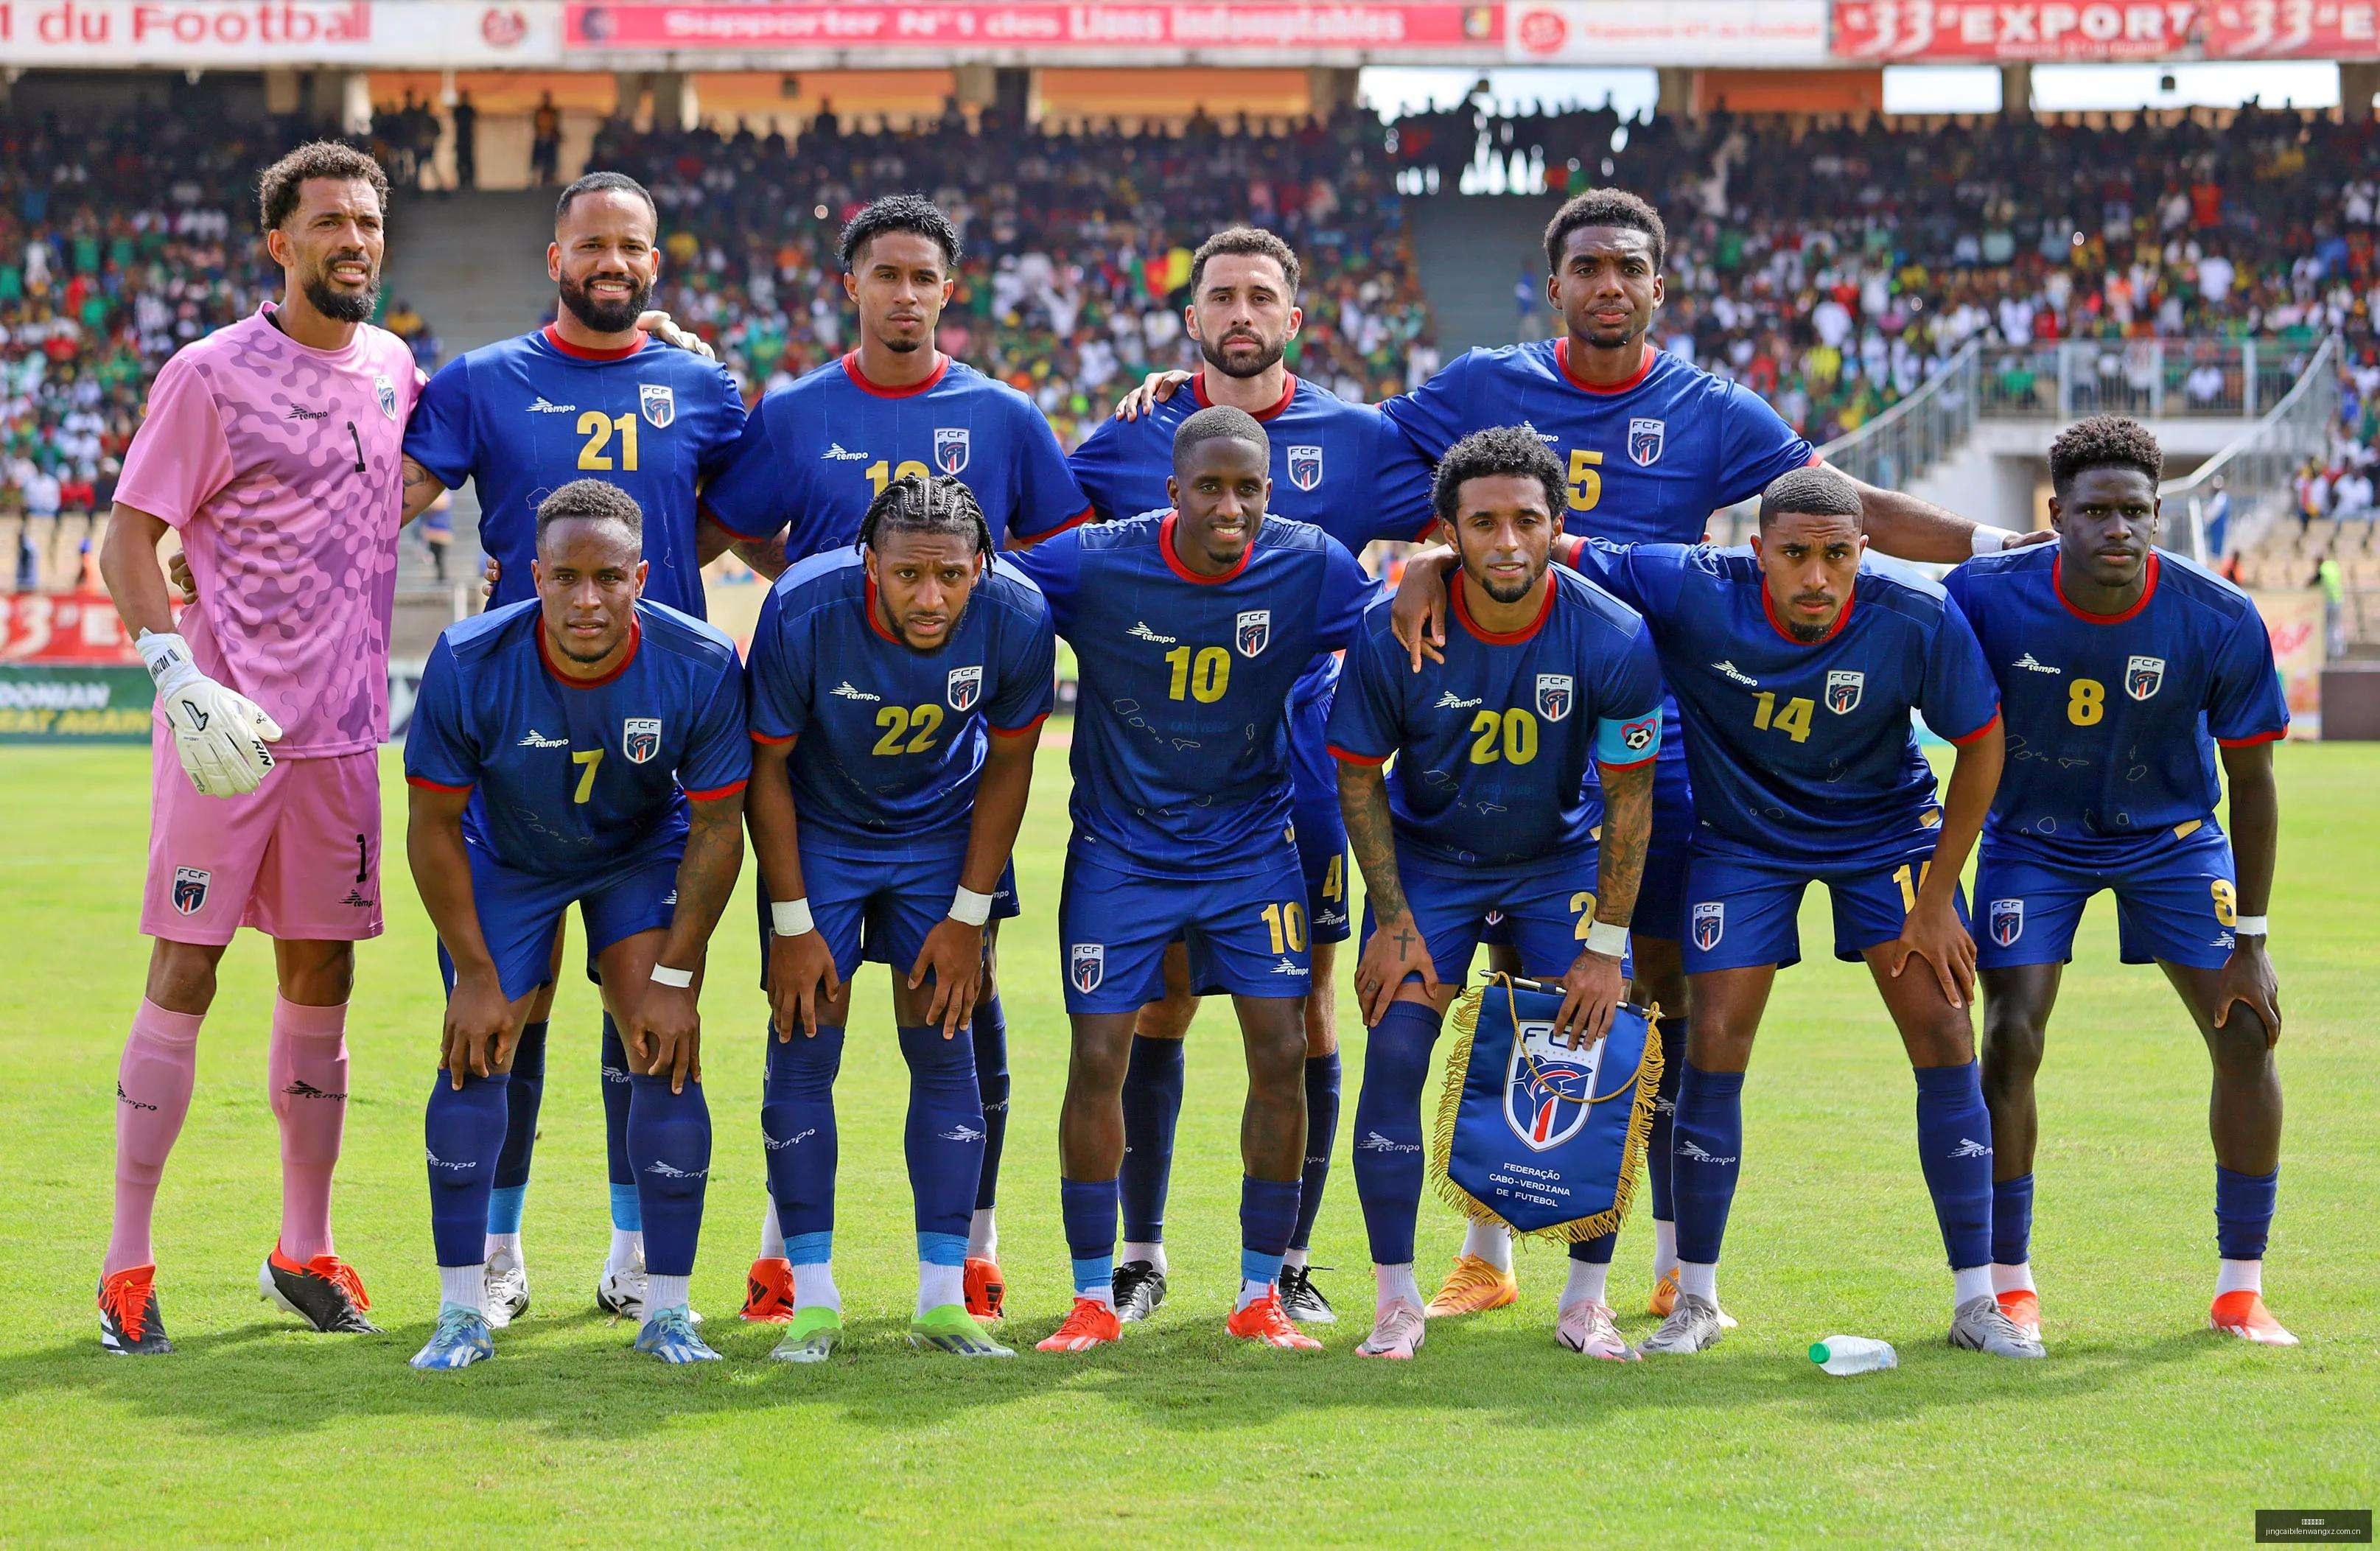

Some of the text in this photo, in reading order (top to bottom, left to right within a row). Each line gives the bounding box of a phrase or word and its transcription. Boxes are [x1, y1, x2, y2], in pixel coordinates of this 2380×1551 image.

[38, 0, 111, 42] du
[667, 10, 881, 39] Supporter
[984, 10, 1061, 35] des
[1071, 7, 1162, 39] Lions
[1174, 7, 1404, 44] Indomptables
[1960, 4, 2194, 43] EXPORT
[543, 404, 575, 413] tempo
[299, 410, 327, 420] tempo
[1632, 421, 1662, 429] FCF
[937, 430, 965, 438] FCF
[1535, 433, 1558, 442] mpo
[347, 421, 365, 472] 1
[576, 411, 637, 471] 21
[836, 451, 868, 461] tempo
[1291, 448, 1318, 456] FCF
[1569, 449, 1603, 511] 5
[1239, 613, 1267, 623] FCF
[1142, 631, 1176, 643] tempo
[2029, 662, 2061, 675] tempo
[2131, 658, 2162, 668] FCF
[951, 669, 979, 679] FCF
[1164, 646, 1231, 703] 10
[1726, 670, 1758, 687] tempo
[1830, 673, 1861, 682] FCF
[1539, 676, 1569, 685] FCF
[847, 690, 880, 701] tempo
[1451, 696, 1483, 709] tempo
[2068, 679, 2105, 727] 8
[1751, 690, 1816, 743] 14
[627, 721, 658, 729] FCF
[872, 704, 944, 755] 22
[1469, 708, 1539, 765] 20
[535, 738, 569, 748] tempo
[251, 740, 273, 766] RIN
[572, 749, 604, 803] 7
[356, 834, 367, 883] 1
[178, 869, 209, 880] FCF
[1322, 854, 1342, 903] 4
[993, 890, 1009, 898] mpo
[1992, 901, 2020, 909] FCF
[2211, 880, 2236, 926] 8
[1695, 905, 1721, 914] FCF
[1569, 892, 1597, 940] 2
[1260, 902, 1306, 954] 10
[1074, 946, 1100, 954] FCF
[611, 1074, 631, 1082] tem
[766, 1128, 816, 1149] tempo
[1378, 1143, 1420, 1153] tempo
[1971, 1146, 1993, 1158] tem
[430, 1160, 476, 1171] tempo
[1694, 1154, 1736, 1166] tempo
[1504, 1163, 1560, 1180] FEDERAÇÃO
[1489, 1173, 1570, 1196] CABO-VERDIANA
[1496, 1188, 1558, 1207] DE FUTEBOL
